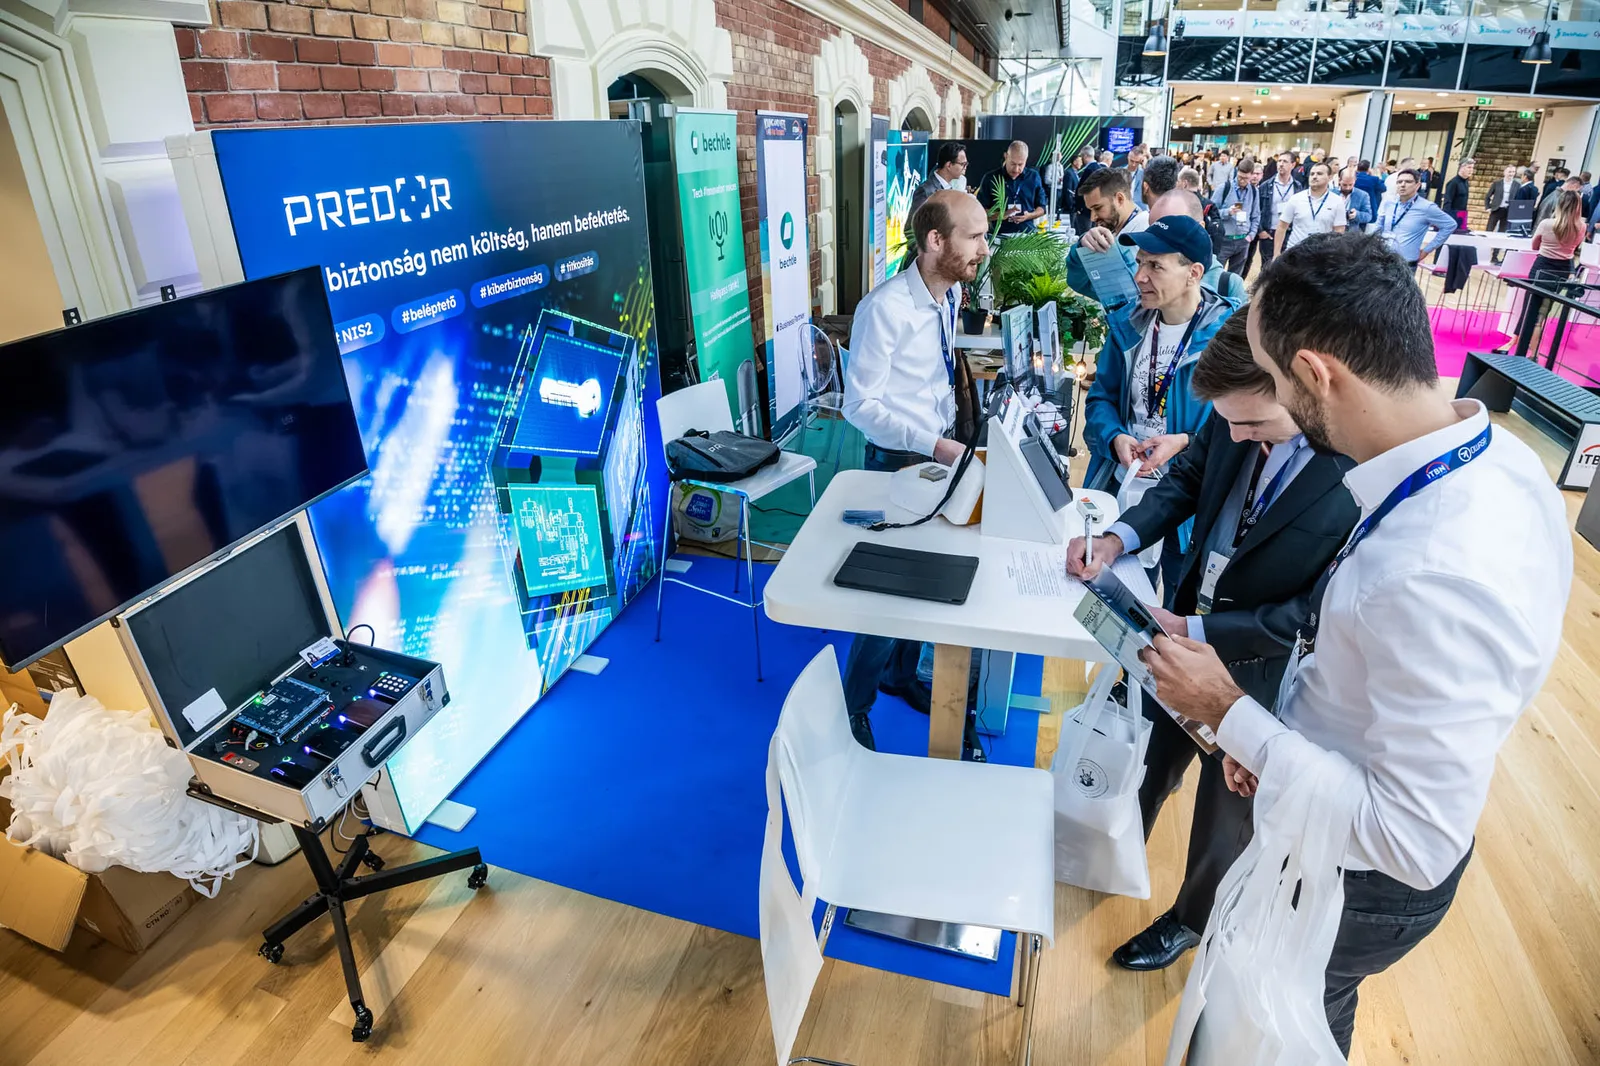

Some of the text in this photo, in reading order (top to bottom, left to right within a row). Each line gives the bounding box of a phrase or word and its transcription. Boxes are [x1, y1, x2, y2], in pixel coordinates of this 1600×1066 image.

[702, 132, 731, 152] bechtle
[325, 205, 630, 292] biztonság nem költség, hanem befektetés.
[779, 254, 797, 269] bechtle
[1426, 464, 1447, 479] ITBN
